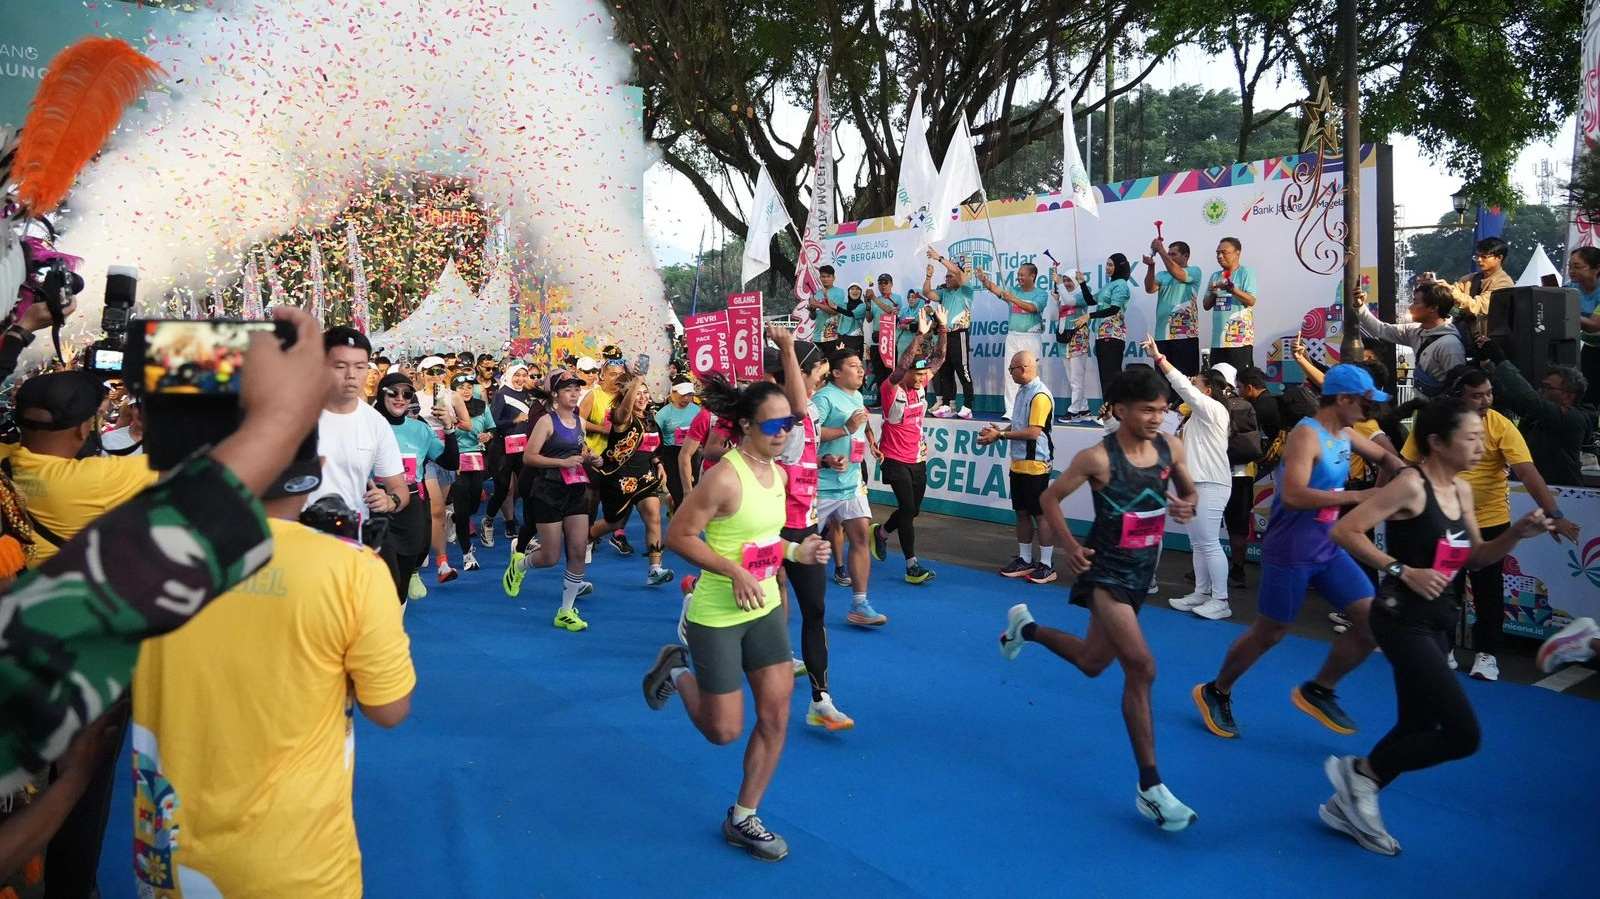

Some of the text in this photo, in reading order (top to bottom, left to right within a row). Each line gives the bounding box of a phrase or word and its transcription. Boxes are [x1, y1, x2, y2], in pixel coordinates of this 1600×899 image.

[1253, 203, 1274, 216] Bank
[850, 250, 894, 262] BERGAUNG
[997, 252, 1036, 269] Tidar
[695, 315, 717, 326] JEVRI
[733, 329, 749, 360] 6
[751, 317, 759, 362] PACER
[880, 335, 888, 355] 8
[695, 344, 714, 372] 6
[716, 332, 730, 370] PACER
[744, 365, 759, 377] 10K
[954, 429, 1008, 459] RUN
